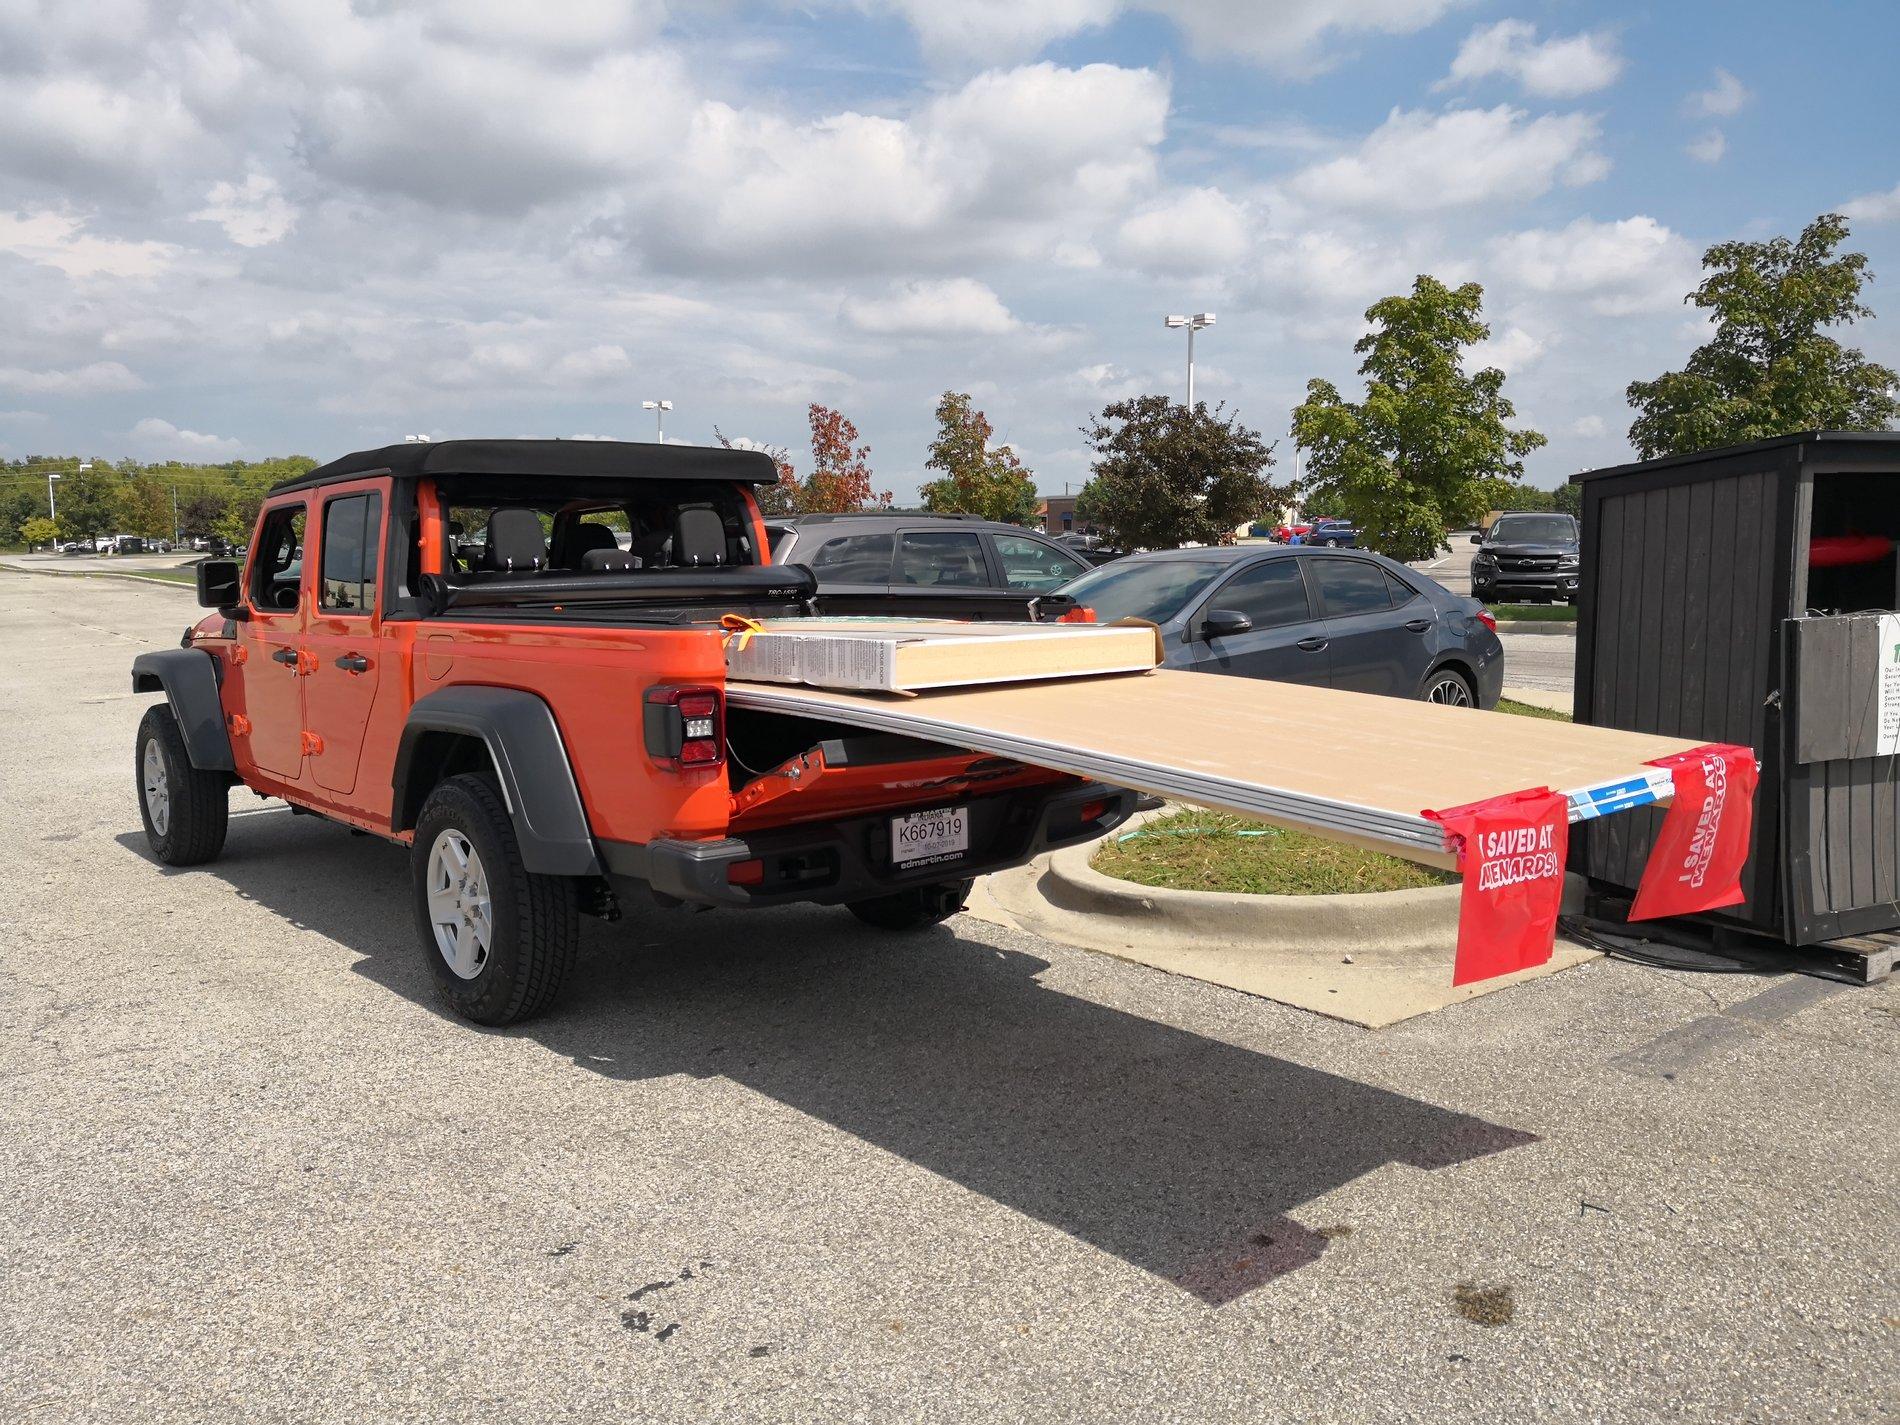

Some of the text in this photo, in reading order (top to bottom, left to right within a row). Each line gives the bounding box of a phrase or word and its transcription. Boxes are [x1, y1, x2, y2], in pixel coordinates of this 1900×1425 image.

[899, 818, 962, 843] K667919
[1678, 760, 1715, 882] I SAVED AT
[1487, 827, 1537, 858] SAVED
[1538, 824, 1554, 850] AT
[900, 852, 963, 870] edmartin.com
